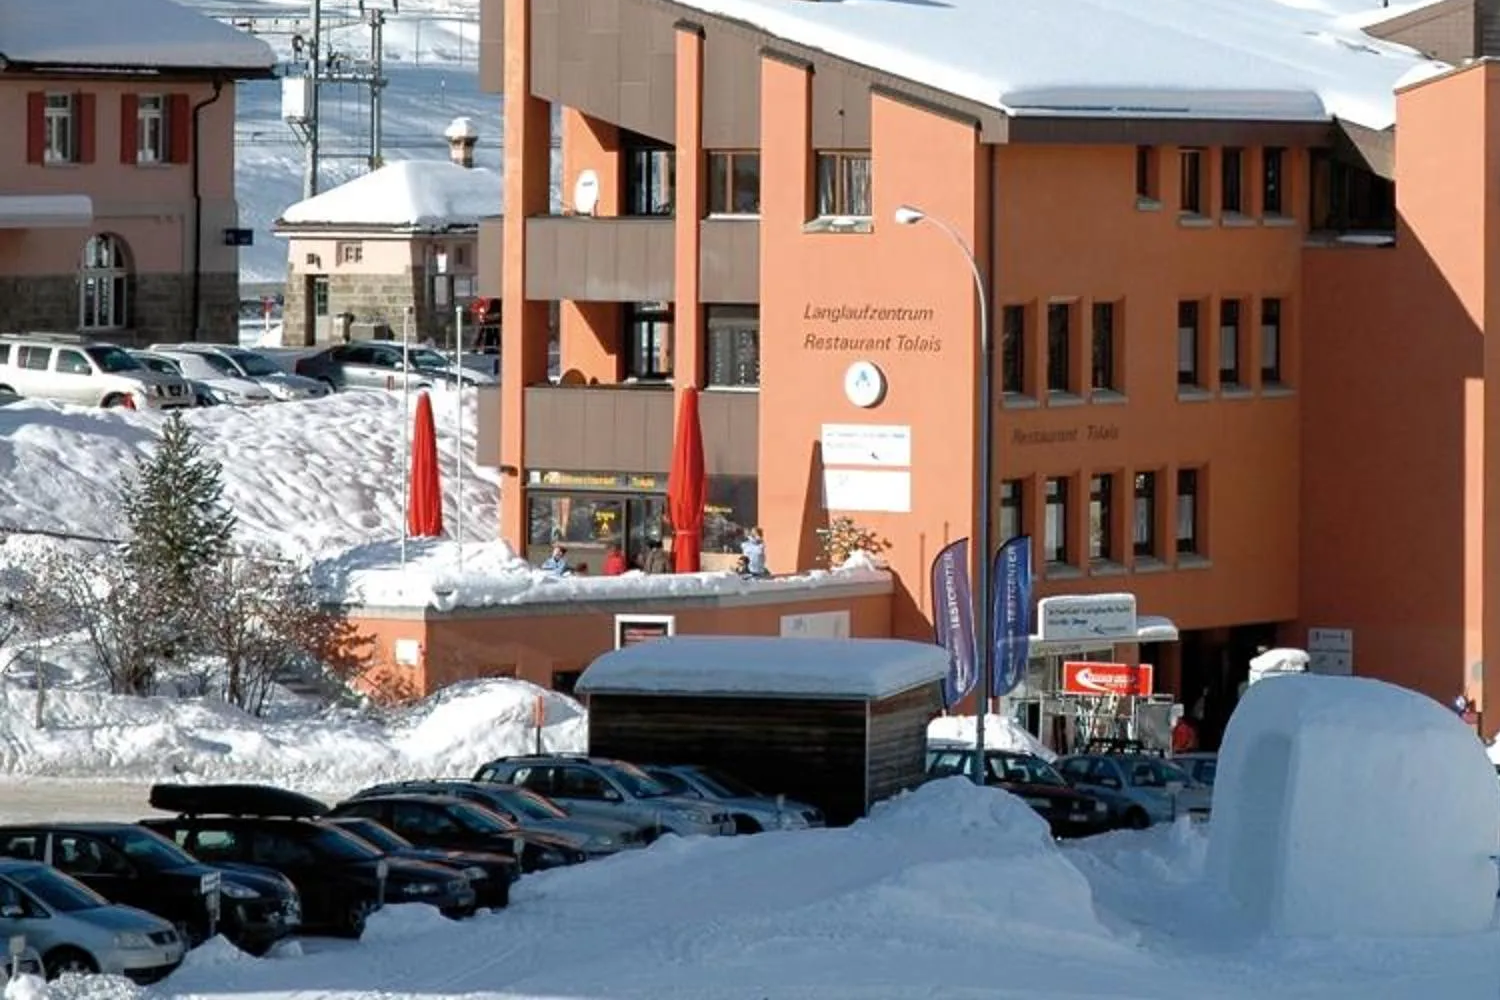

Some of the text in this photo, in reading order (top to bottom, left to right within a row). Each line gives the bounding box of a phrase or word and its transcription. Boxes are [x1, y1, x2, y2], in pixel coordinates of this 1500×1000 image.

[804, 302, 934, 322] Langlaufzentrum
[804, 333, 942, 352] Restaurant Tolais
[1011, 427, 1078, 446] Restaurant
